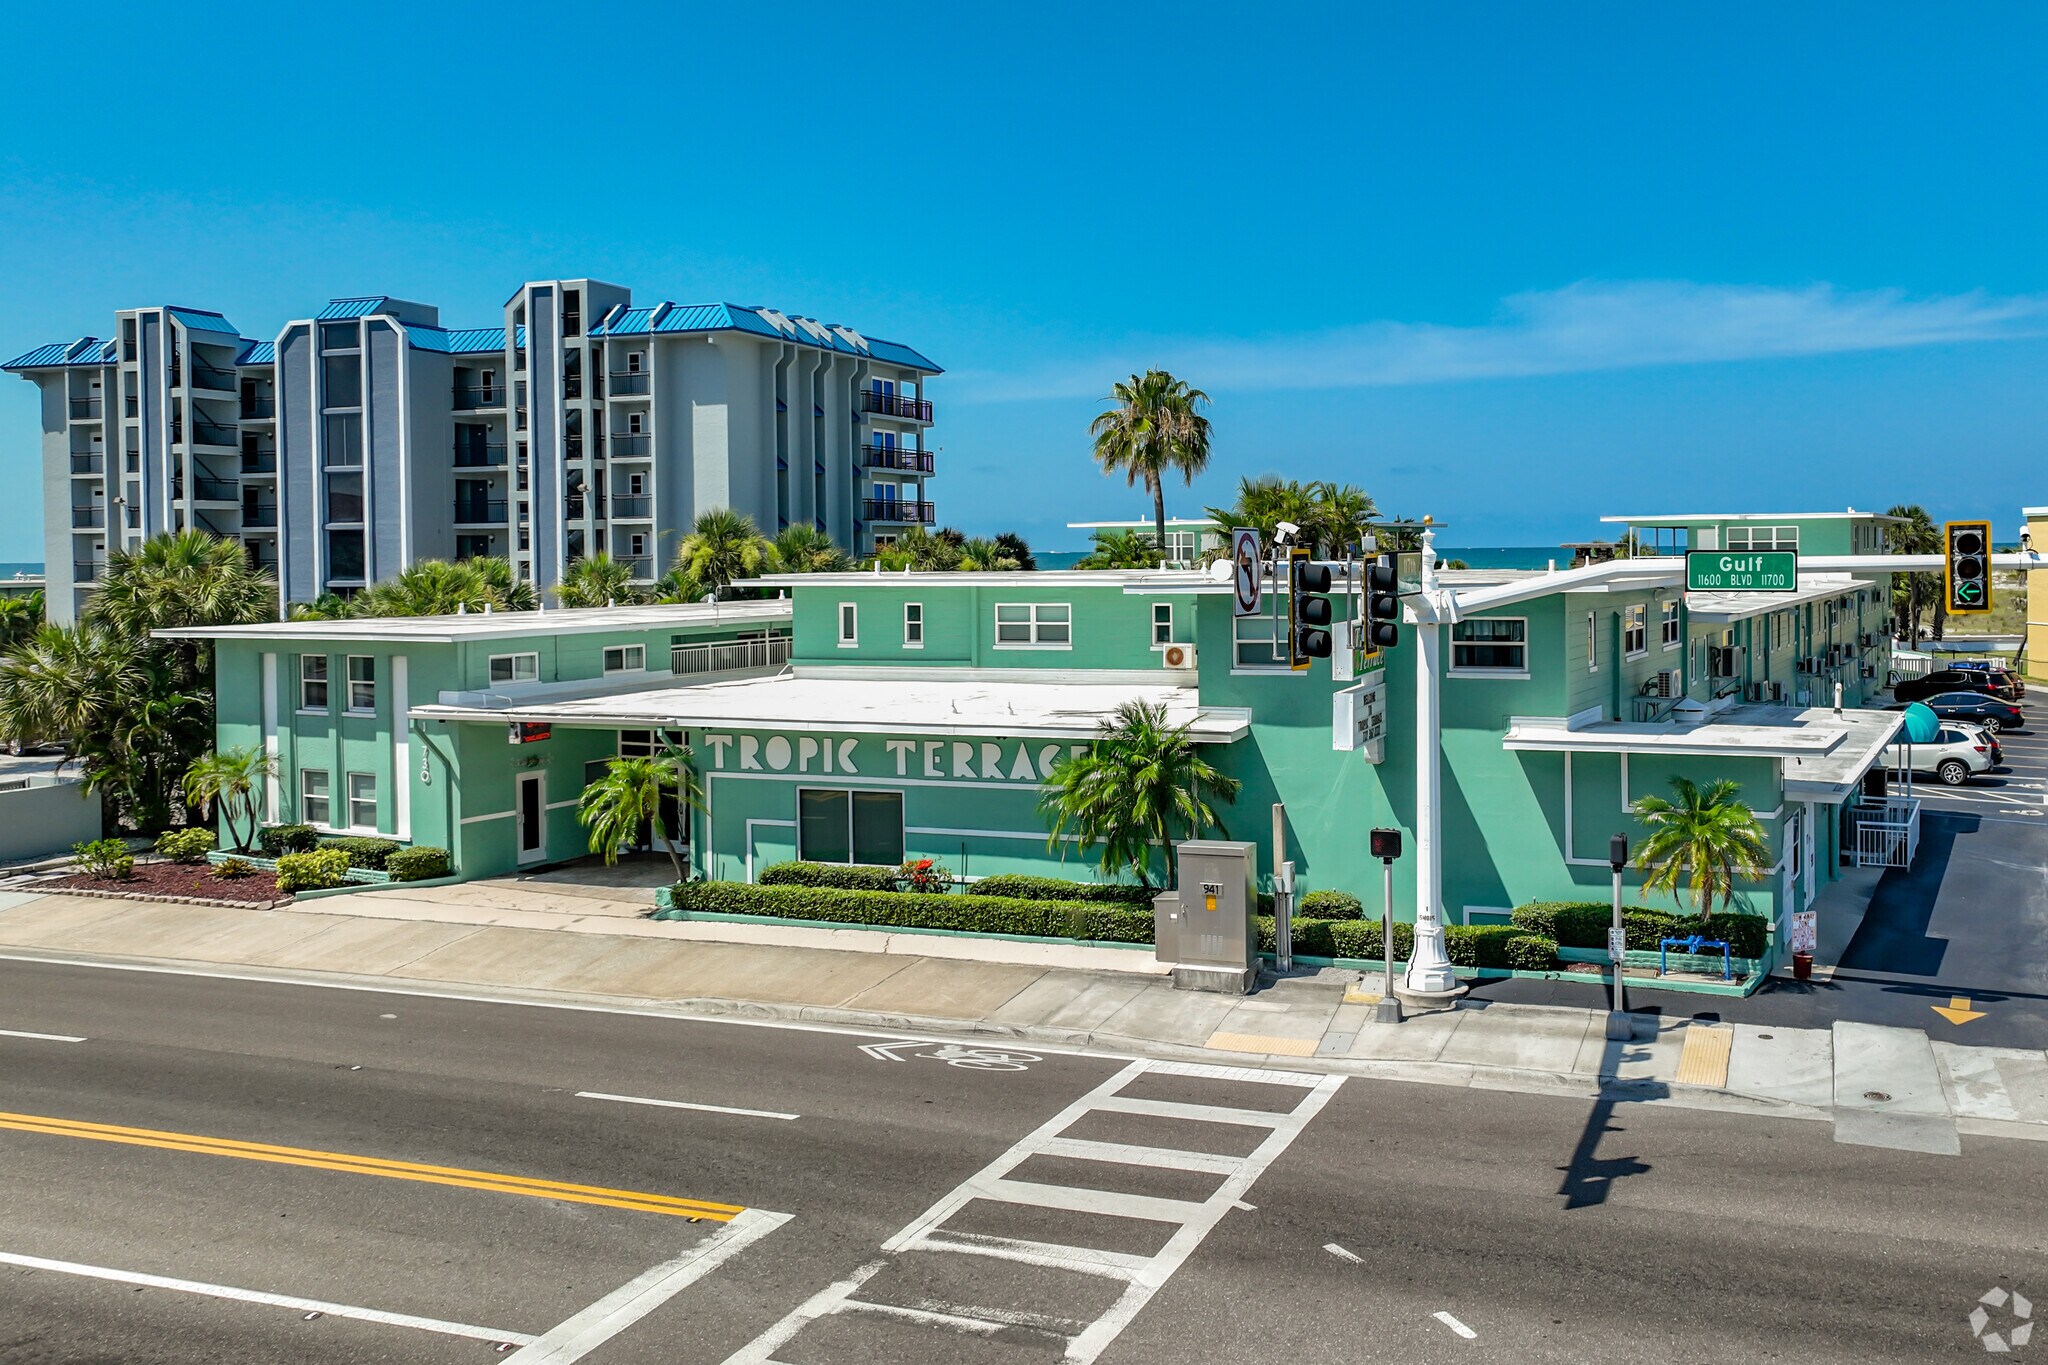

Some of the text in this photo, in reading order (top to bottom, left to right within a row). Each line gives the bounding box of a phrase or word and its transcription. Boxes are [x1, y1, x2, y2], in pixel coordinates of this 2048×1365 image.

[1719, 556, 1763, 572] Gulf
[1698, 574, 1785, 586] 11600 BLVD 11700
[704, 734, 860, 774] TROPIC
[1203, 884, 1219, 895] 941
